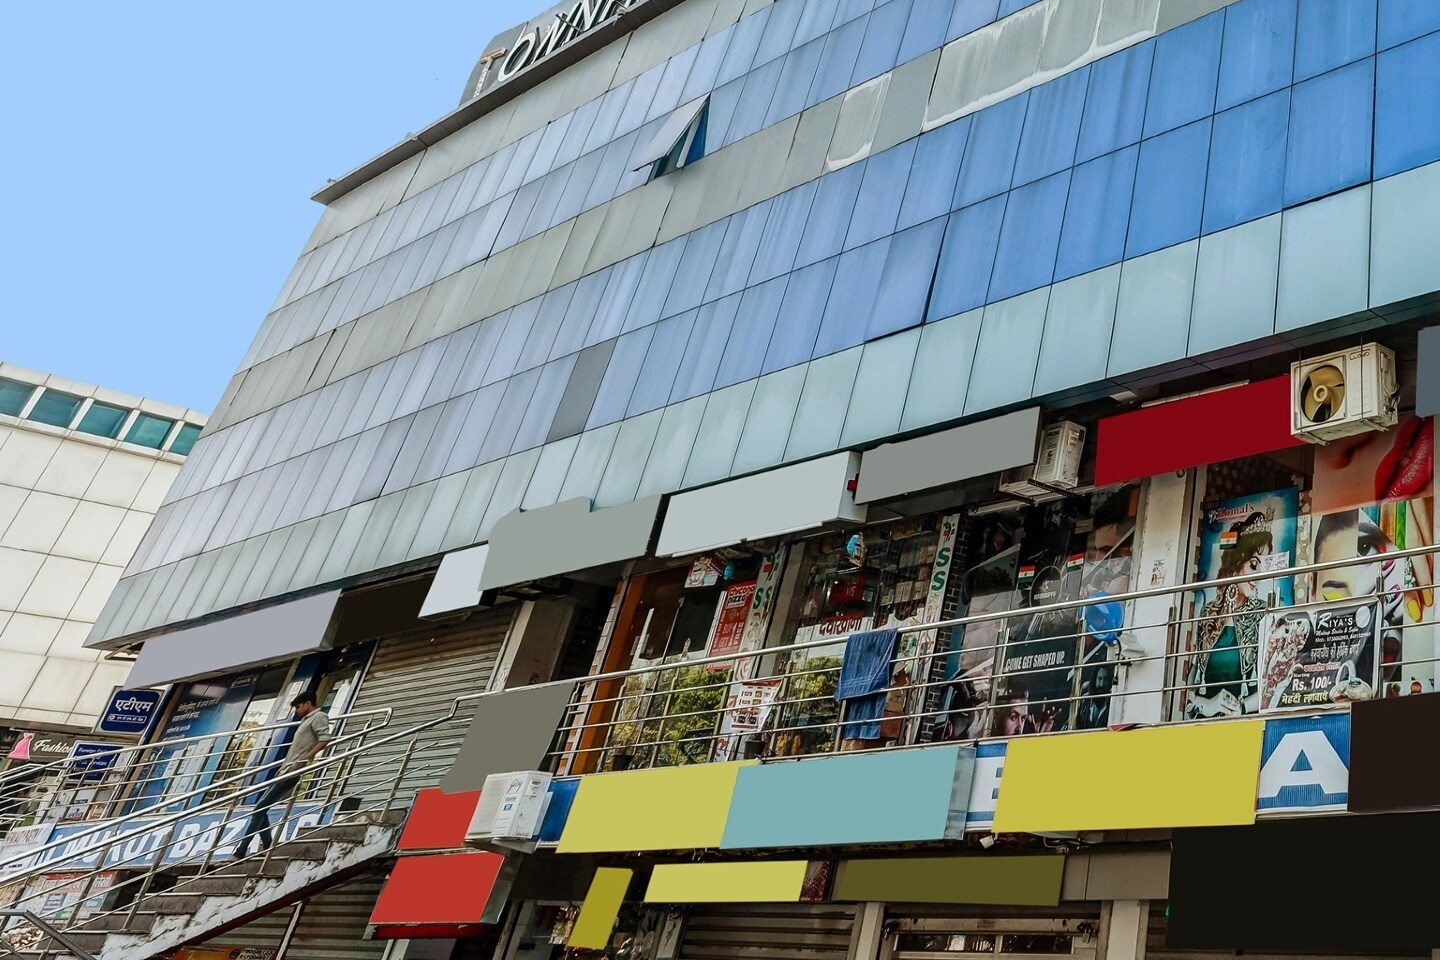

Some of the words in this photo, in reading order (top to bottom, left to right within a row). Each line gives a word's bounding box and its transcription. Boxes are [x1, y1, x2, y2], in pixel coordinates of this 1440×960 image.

[1318, 612, 1353, 630] RIYA'S
[1022, 655, 1033, 669] GET
[1033, 651, 1056, 668] SHAPED
[1292, 678, 1307, 691] Rs.
[1311, 676, 1331, 689] 100/-
[115, 696, 153, 713] एटीएम
